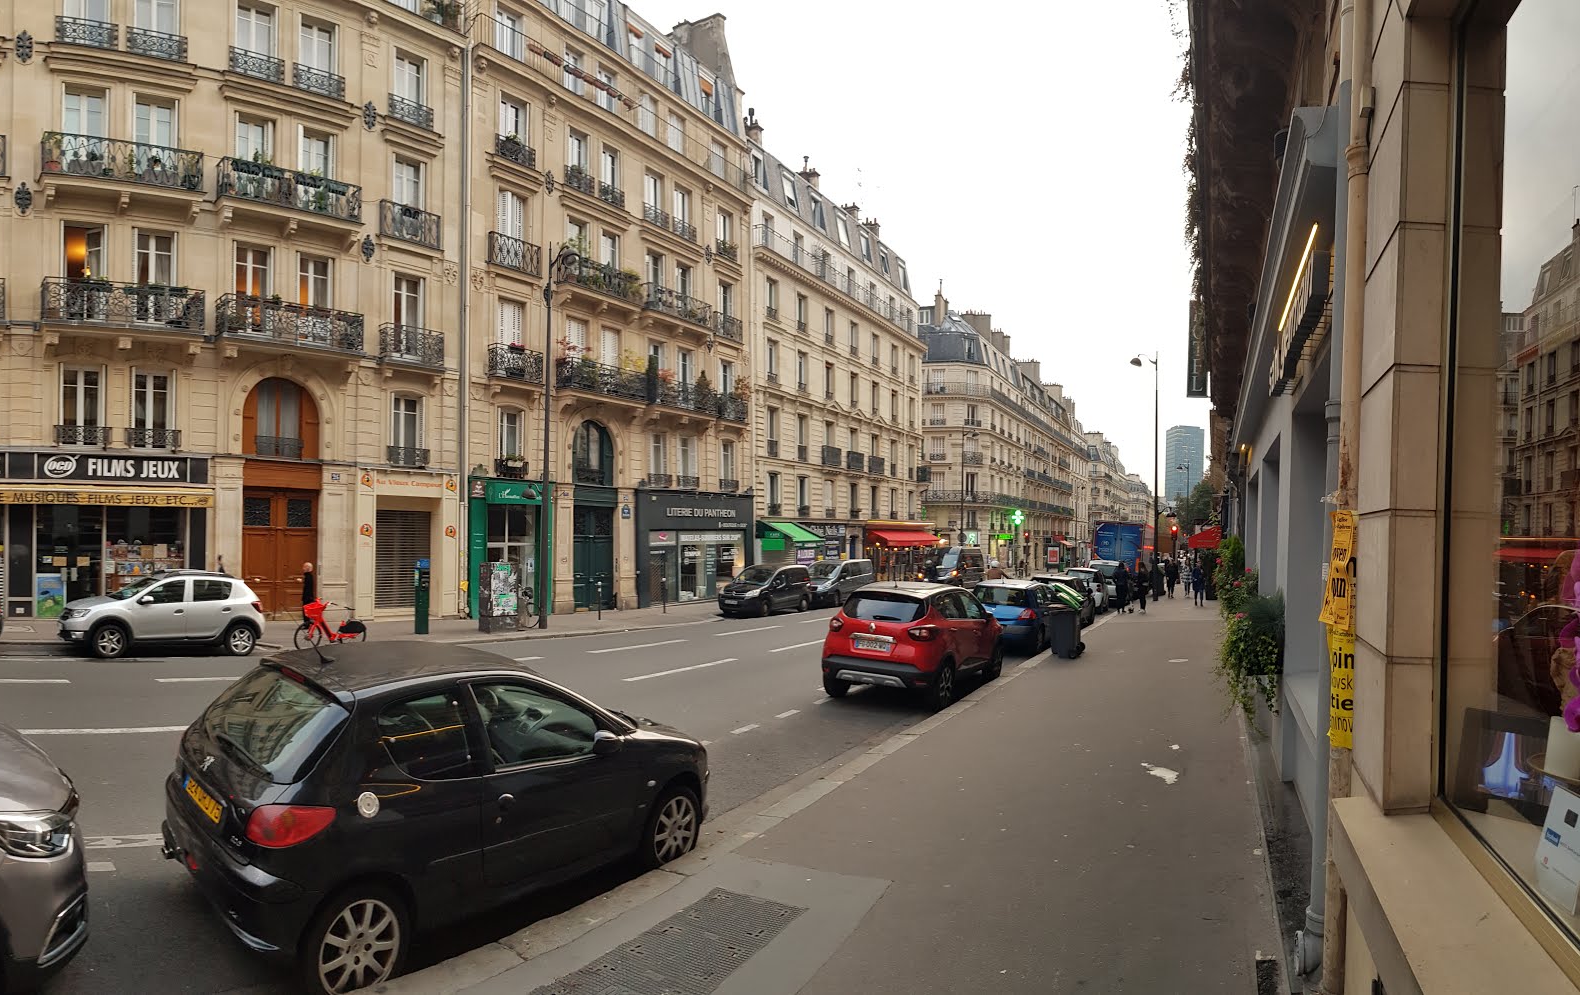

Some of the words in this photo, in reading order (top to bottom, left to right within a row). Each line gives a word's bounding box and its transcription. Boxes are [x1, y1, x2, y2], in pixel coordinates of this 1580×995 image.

[87, 458, 136, 478] FILMS
[139, 460, 180, 479] JEUX
[410, 480, 442, 489] Campeur
[12, 492, 80, 503] MUSIQUES
[87, 494, 121, 504] FILMS
[129, 495, 159, 505] JEUX
[666, 507, 693, 517] LITERIE
[693, 508, 704, 517] DU
[704, 508, 736, 518] PANTHEON
